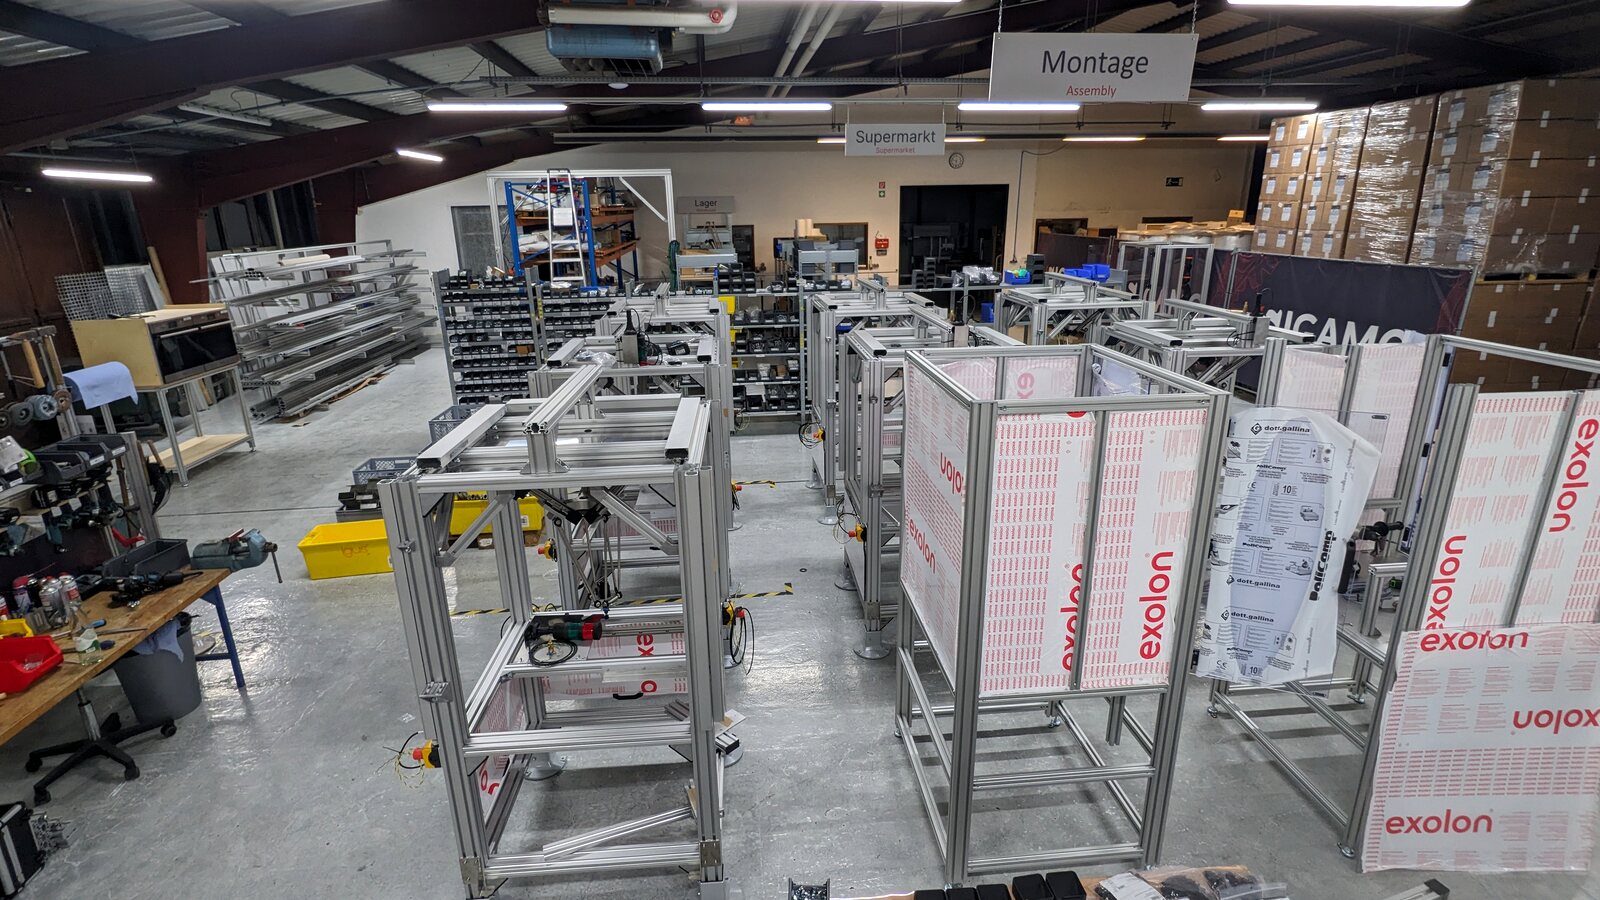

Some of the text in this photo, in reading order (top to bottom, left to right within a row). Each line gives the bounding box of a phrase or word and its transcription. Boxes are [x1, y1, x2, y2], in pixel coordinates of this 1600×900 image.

[1042, 50, 1149, 79] Montage
[1066, 85, 1117, 98] Assembly
[855, 130, 936, 146] Supermarkt
[694, 199, 718, 209] Lager
[940, 452, 964, 495] olon
[1548, 418, 1600, 533] exolon
[1282, 485, 1292, 494] 10
[909, 518, 936, 575] exolon
[1236, 577, 1281, 589] dott.gallina
[1139, 551, 1174, 660] exolon
[1230, 611, 1275, 623] dott.gallina
[1512, 708, 1600, 735] xolon
[1385, 808, 1493, 835] exolon
